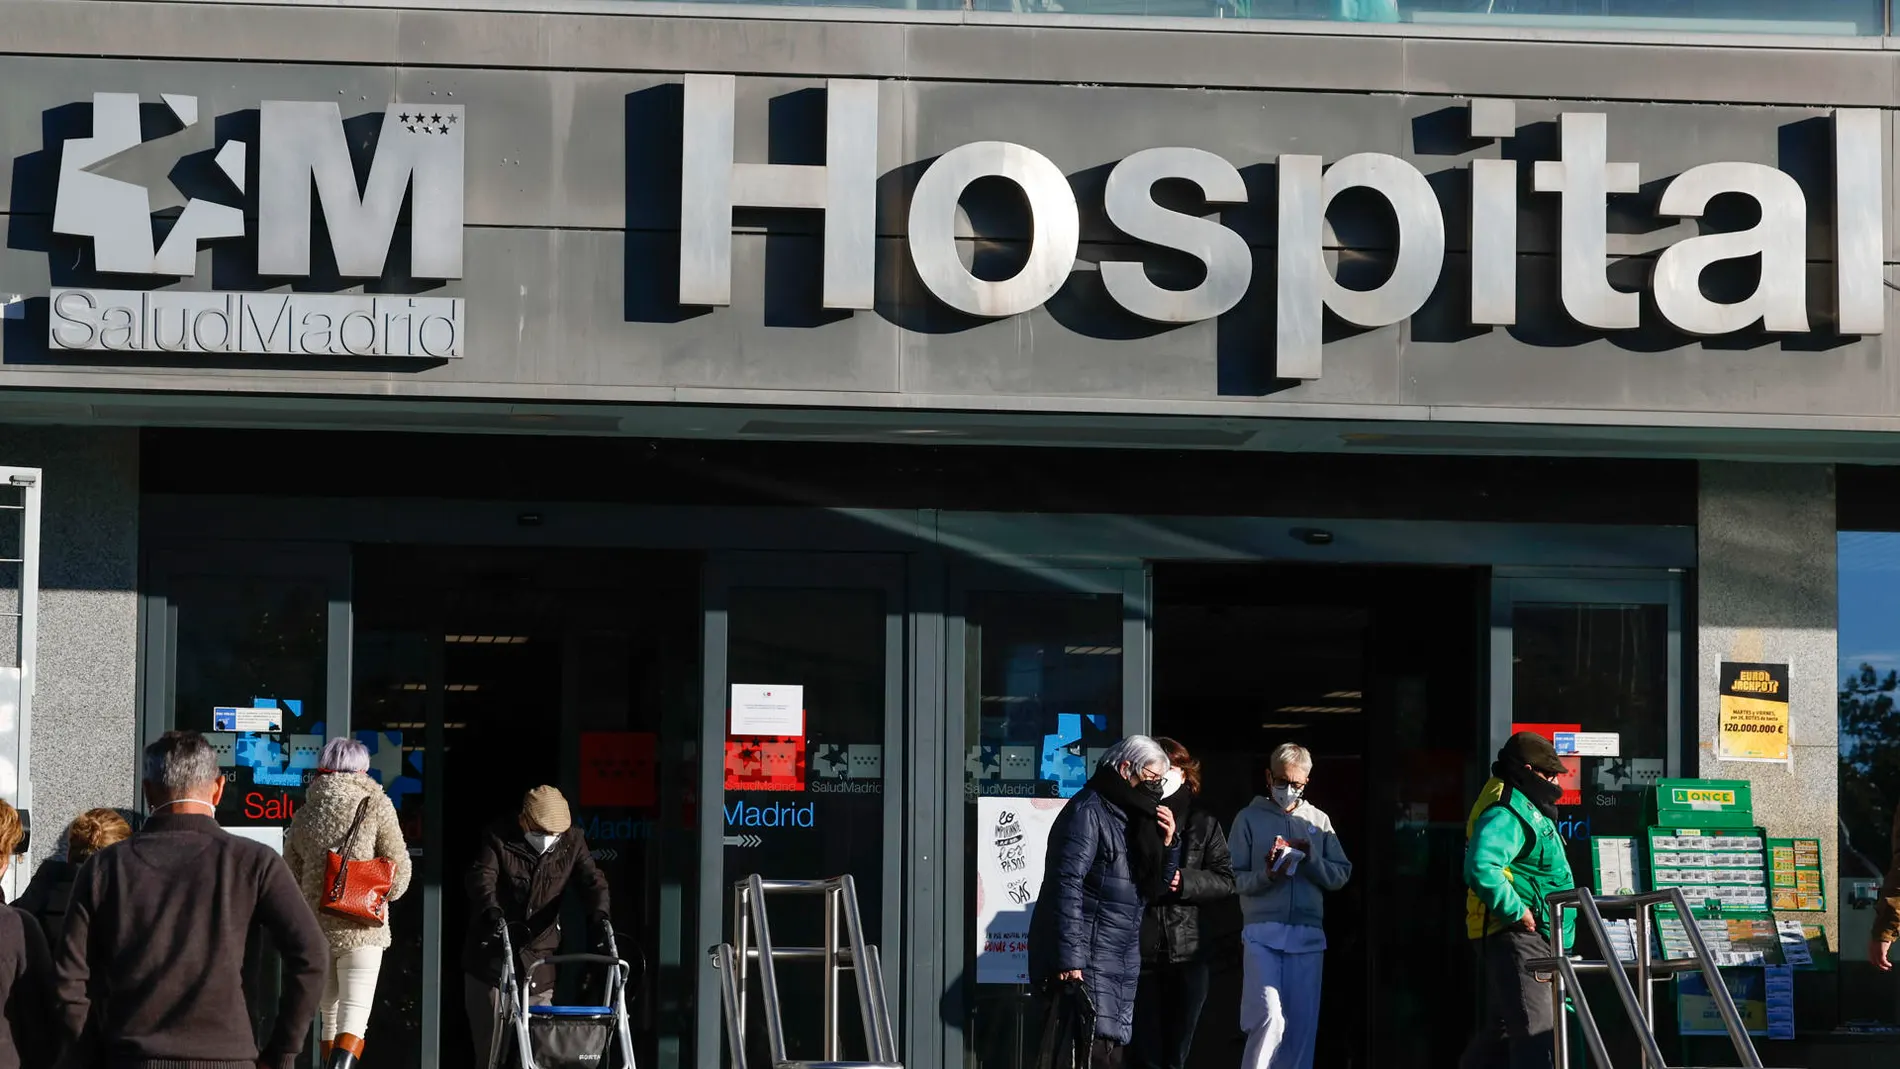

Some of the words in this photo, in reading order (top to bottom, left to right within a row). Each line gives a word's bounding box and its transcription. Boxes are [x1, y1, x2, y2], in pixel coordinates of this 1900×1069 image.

[679, 73, 1883, 380] Hospital
[51, 289, 457, 357] SaludMadrid
[1740, 670, 1770, 681] EURO
[1731, 680, 1778, 693] JACKPOT
[1724, 723, 1776, 734] 120.000.000
[1778, 725, 1784, 734] €
[1691, 792, 1731, 803] ONCE
[724, 801, 815, 828] Madrid
[1008, 881, 1031, 905] DAS
